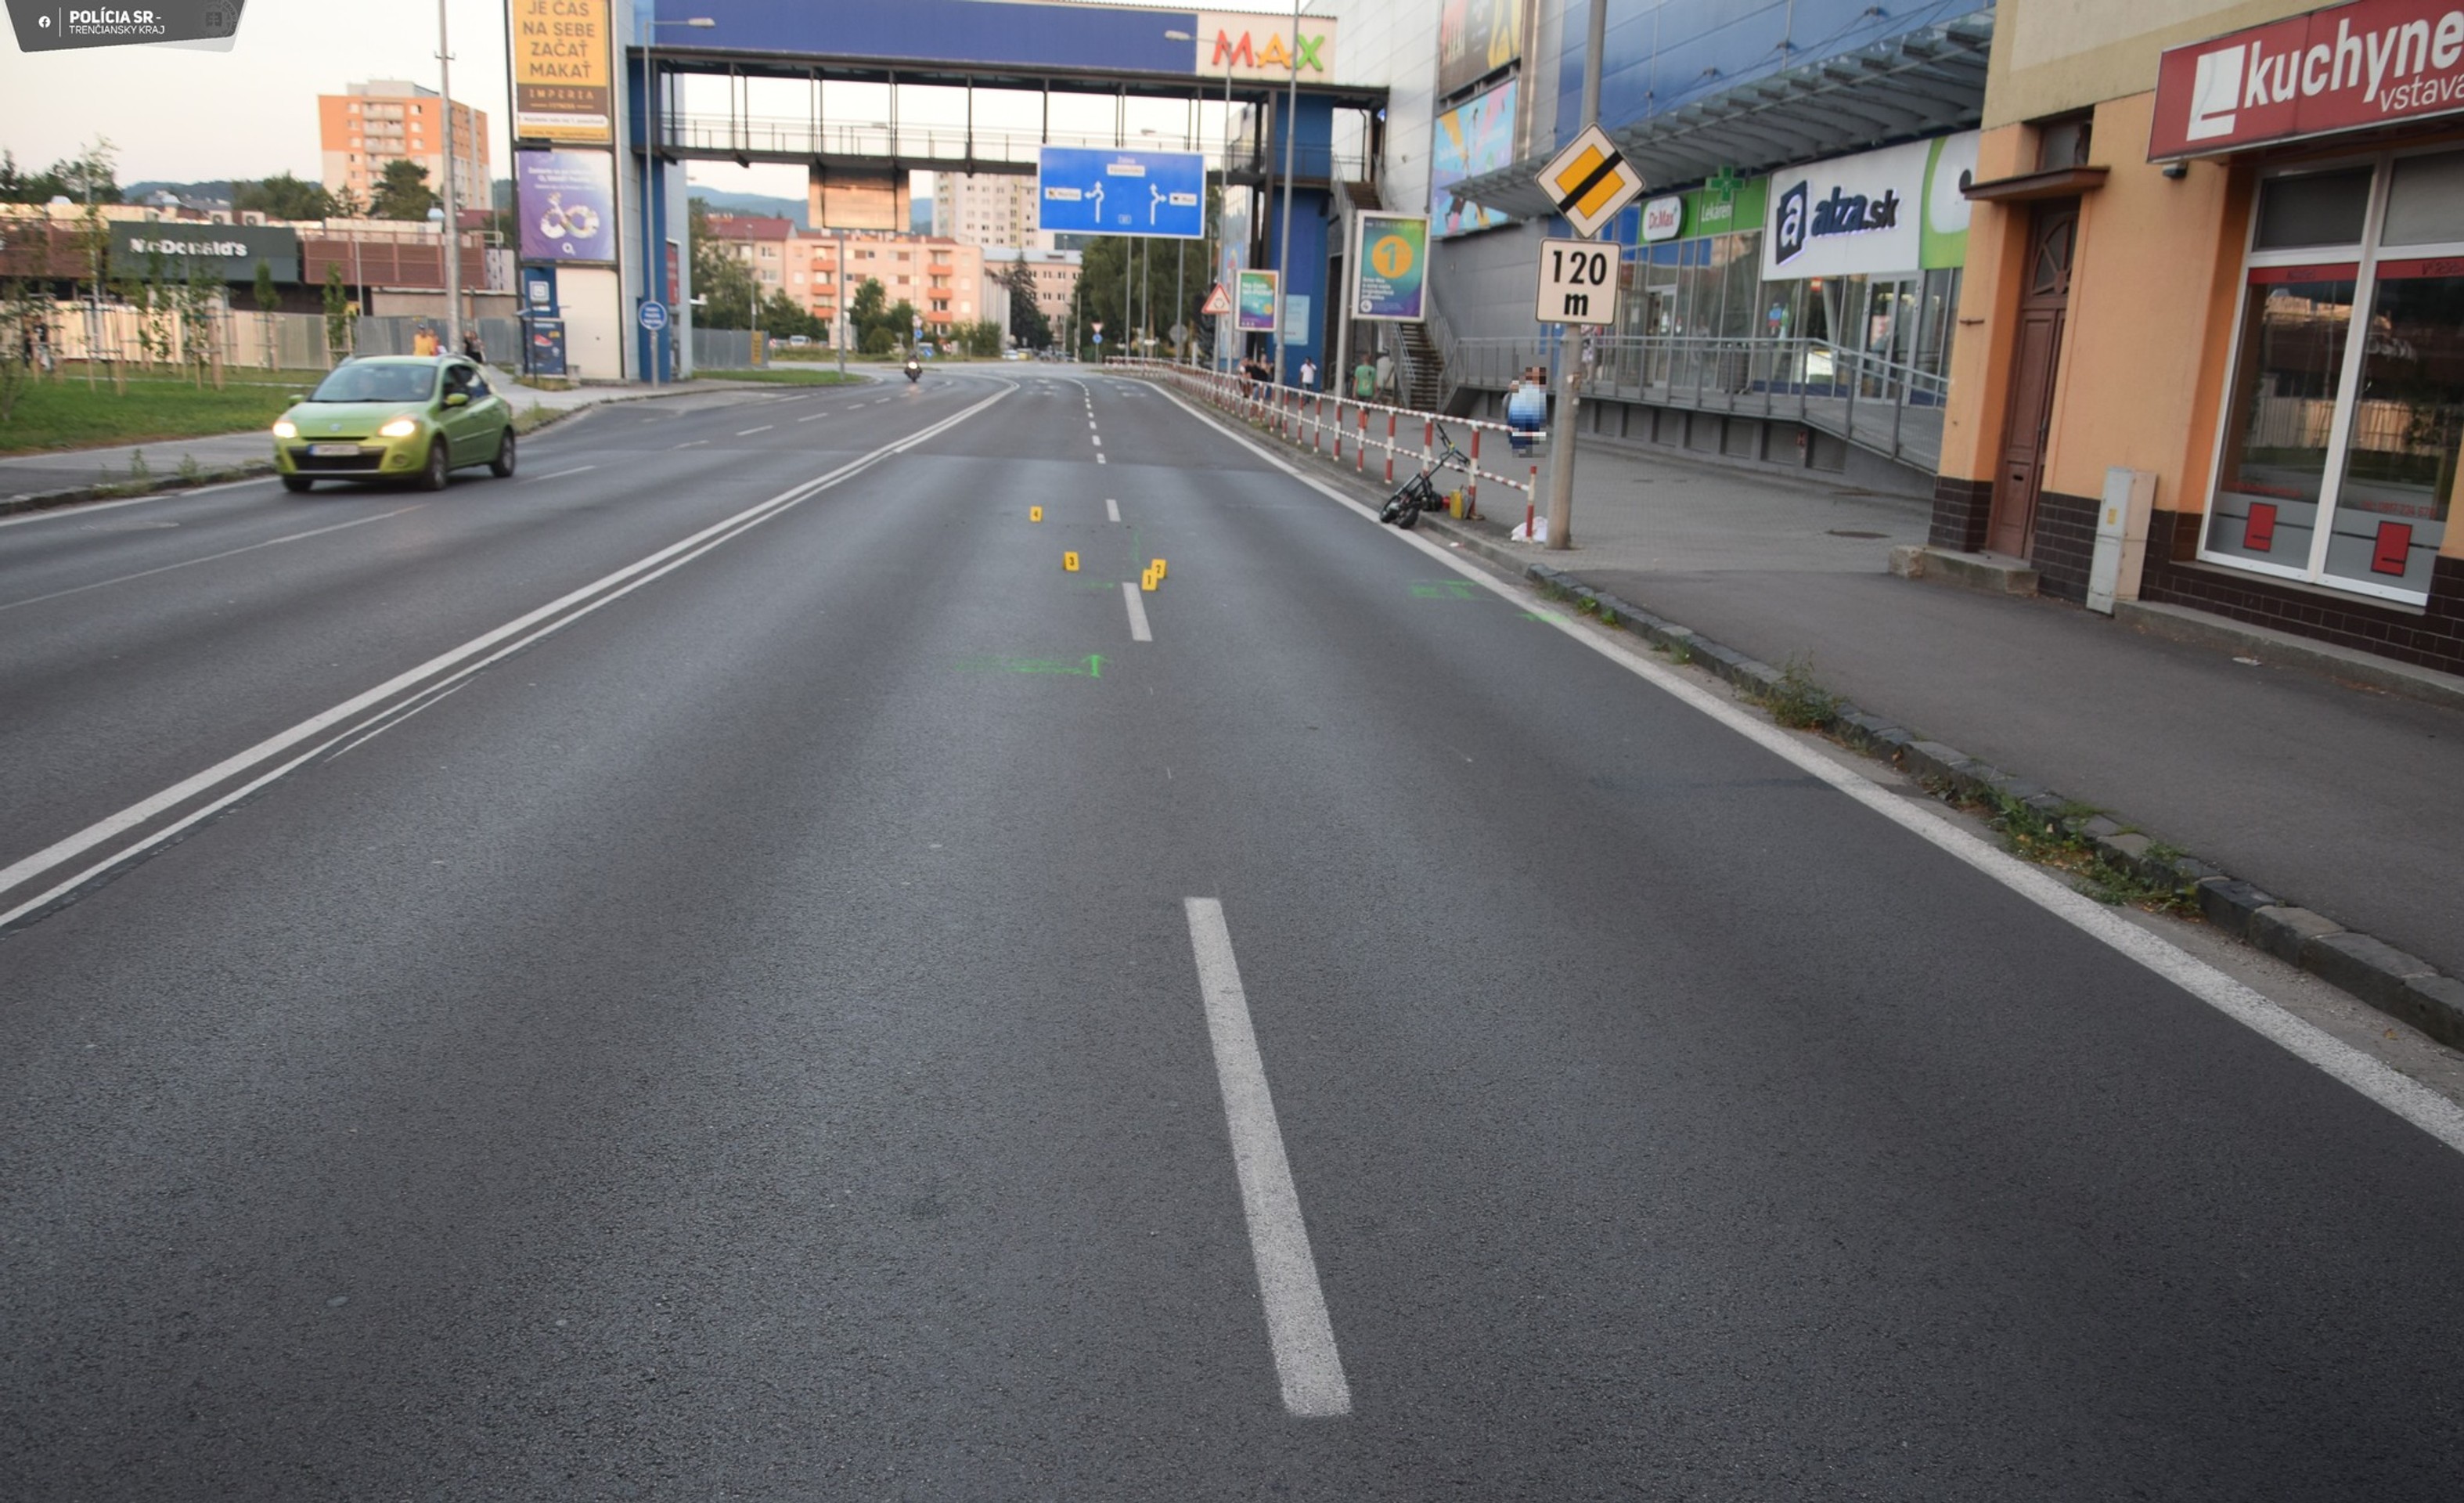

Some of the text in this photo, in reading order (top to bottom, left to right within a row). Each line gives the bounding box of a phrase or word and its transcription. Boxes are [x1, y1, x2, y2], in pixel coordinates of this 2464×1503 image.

[528, 1, 546, 15] JE
[523, 21, 595, 38] NA SEBE
[531, 39, 588, 57] ZAČAŤ
[1212, 29, 1325, 71] MAX
[530, 61, 591, 77] MAKAŤ
[2243, 10, 2464, 109] kuchyne
[1811, 186, 1900, 236] alza.sk
[1554, 250, 1607, 286] 120
[1564, 294, 1589, 316] m
[1069, 557, 1075, 566] 3
